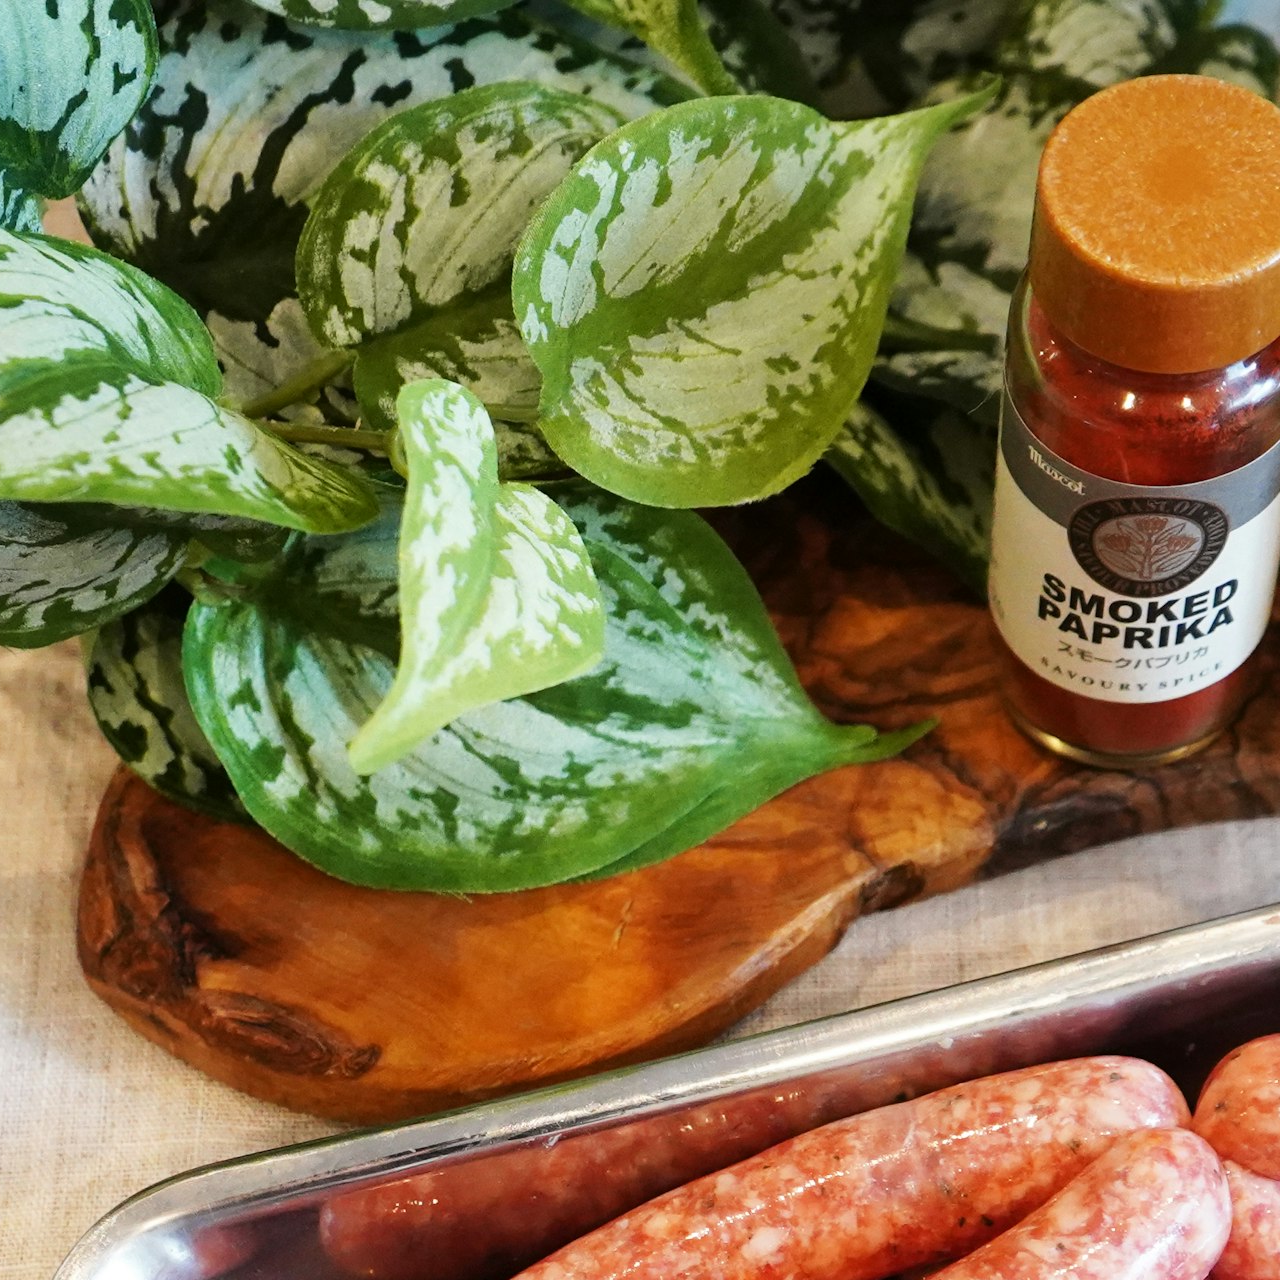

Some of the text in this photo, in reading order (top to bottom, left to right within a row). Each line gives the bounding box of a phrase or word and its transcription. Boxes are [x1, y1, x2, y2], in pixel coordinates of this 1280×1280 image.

[1028, 445, 1086, 496] Mascot
[1037, 596, 1235, 649] PAPRIKA
[1042, 573, 1239, 624] SMOKED
[1040, 656, 1224, 692] SAVOURY SPICE
